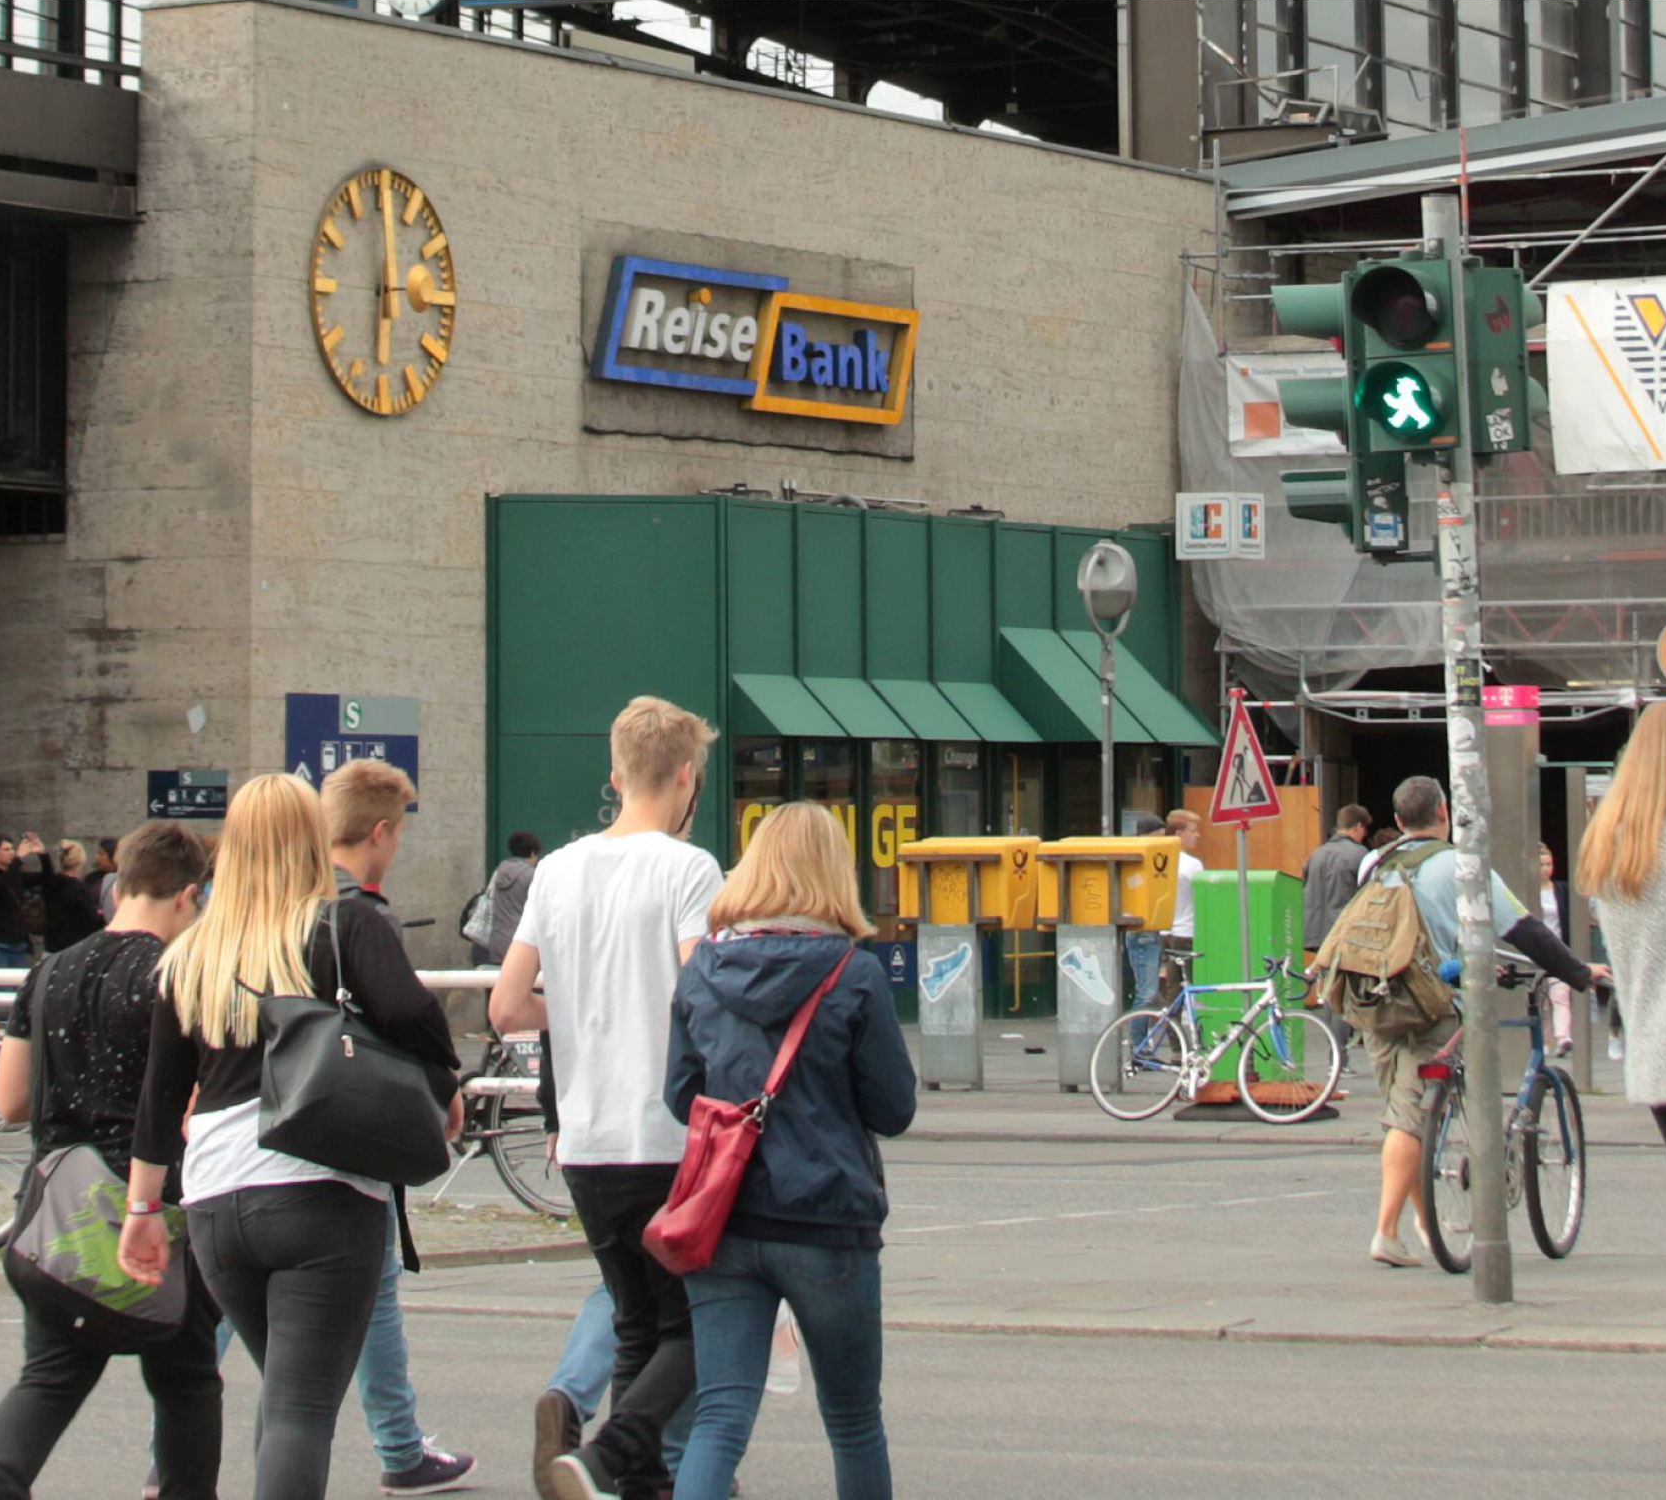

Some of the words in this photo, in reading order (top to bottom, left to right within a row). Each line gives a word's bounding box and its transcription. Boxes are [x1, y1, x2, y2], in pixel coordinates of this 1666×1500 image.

[625, 287, 758, 363] Reise
[773, 320, 889, 393] Bank
[345, 700, 361, 730] S
[740, 803, 917, 869] CNGE
